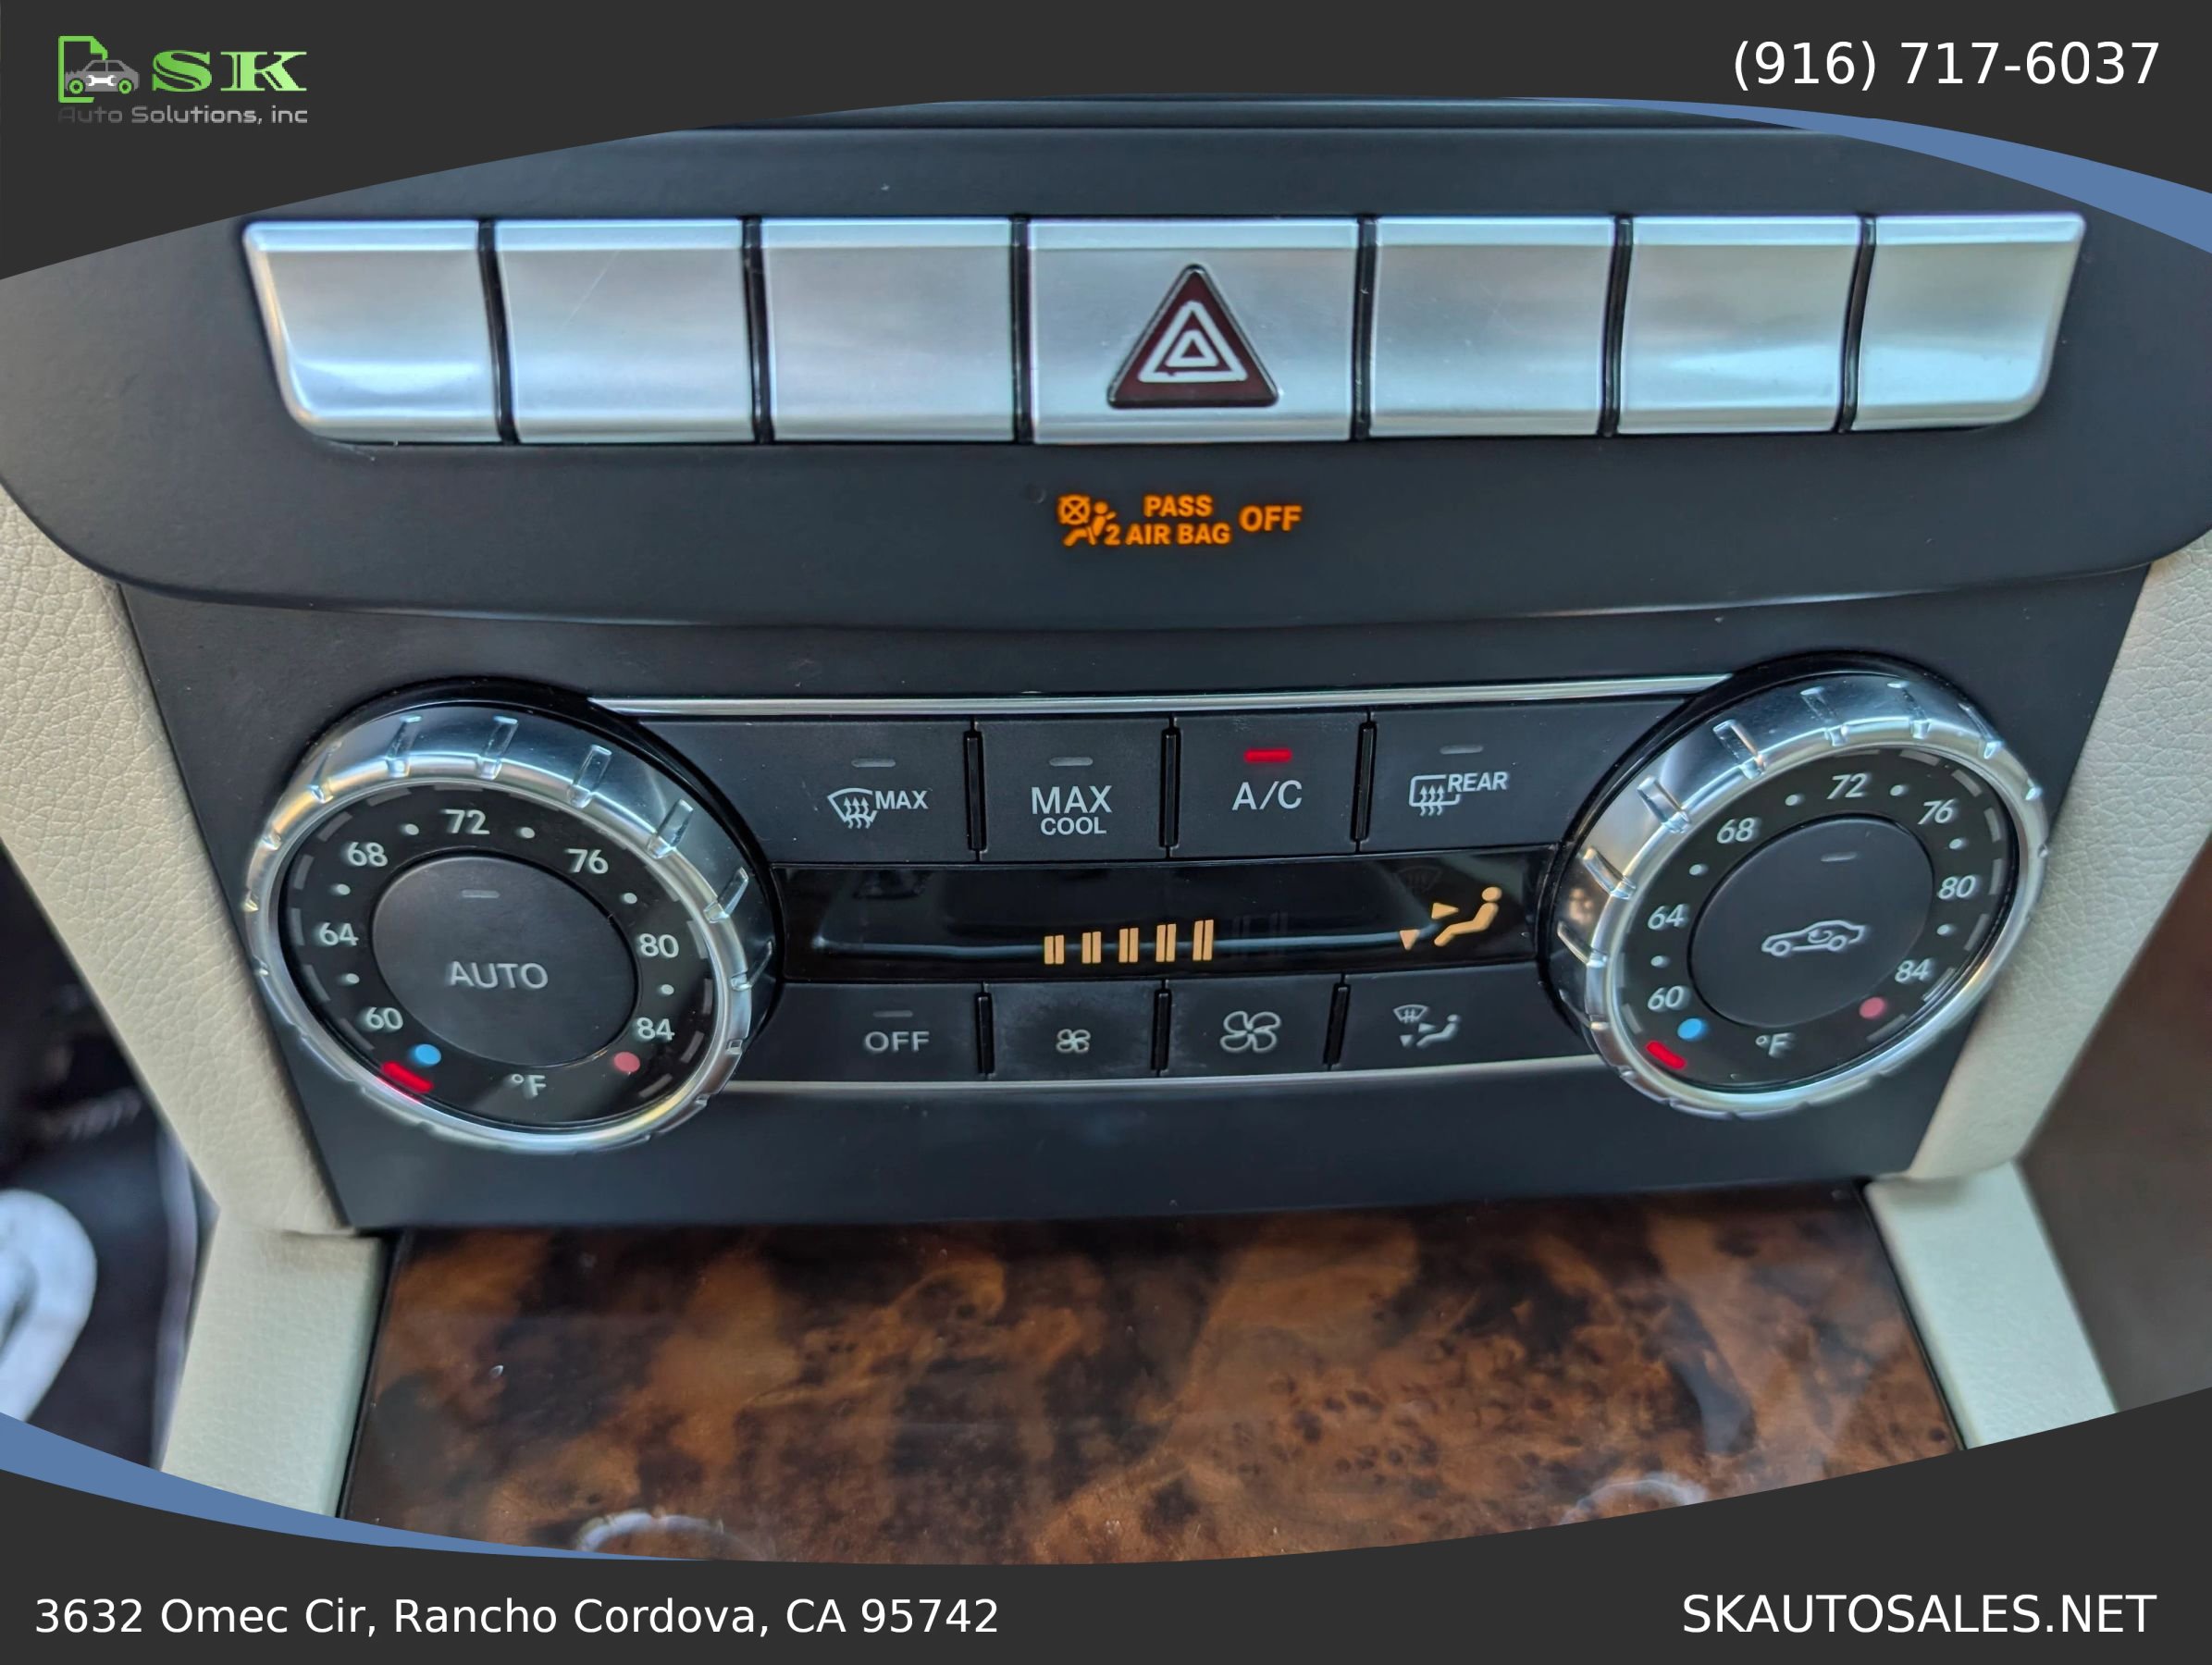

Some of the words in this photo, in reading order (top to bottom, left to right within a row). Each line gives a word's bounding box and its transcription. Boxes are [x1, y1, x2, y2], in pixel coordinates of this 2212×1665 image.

[1145, 495, 1212, 516] PASS
[1240, 506, 1301, 531] OFF
[1125, 524, 1170, 546] AIR
[1177, 523, 1231, 545] BAG
[1449, 771, 1509, 792] REAR
[1827, 773, 1868, 799] 72
[873, 790, 929, 809] MAX
[1032, 785, 1111, 814] MAX
[1232, 780, 1302, 810] A/C
[444, 809, 489, 834] 72
[1920, 799, 1954, 824] 76
[1041, 817, 1106, 835] COOL
[1717, 818, 1757, 844] 68
[346, 842, 388, 866] 68
[568, 849, 608, 873] 76
[1938, 875, 1978, 899] 80
[1649, 905, 1685, 930] 64
[317, 923, 358, 945] 64
[638, 933, 679, 957] 80
[450, 961, 548, 988] AUTO
[1895, 959, 1931, 982] 84
[1648, 986, 1686, 1010] 60
[364, 1007, 402, 1030] 60
[636, 1018, 674, 1040] 84
[865, 1031, 929, 1051] OFF
